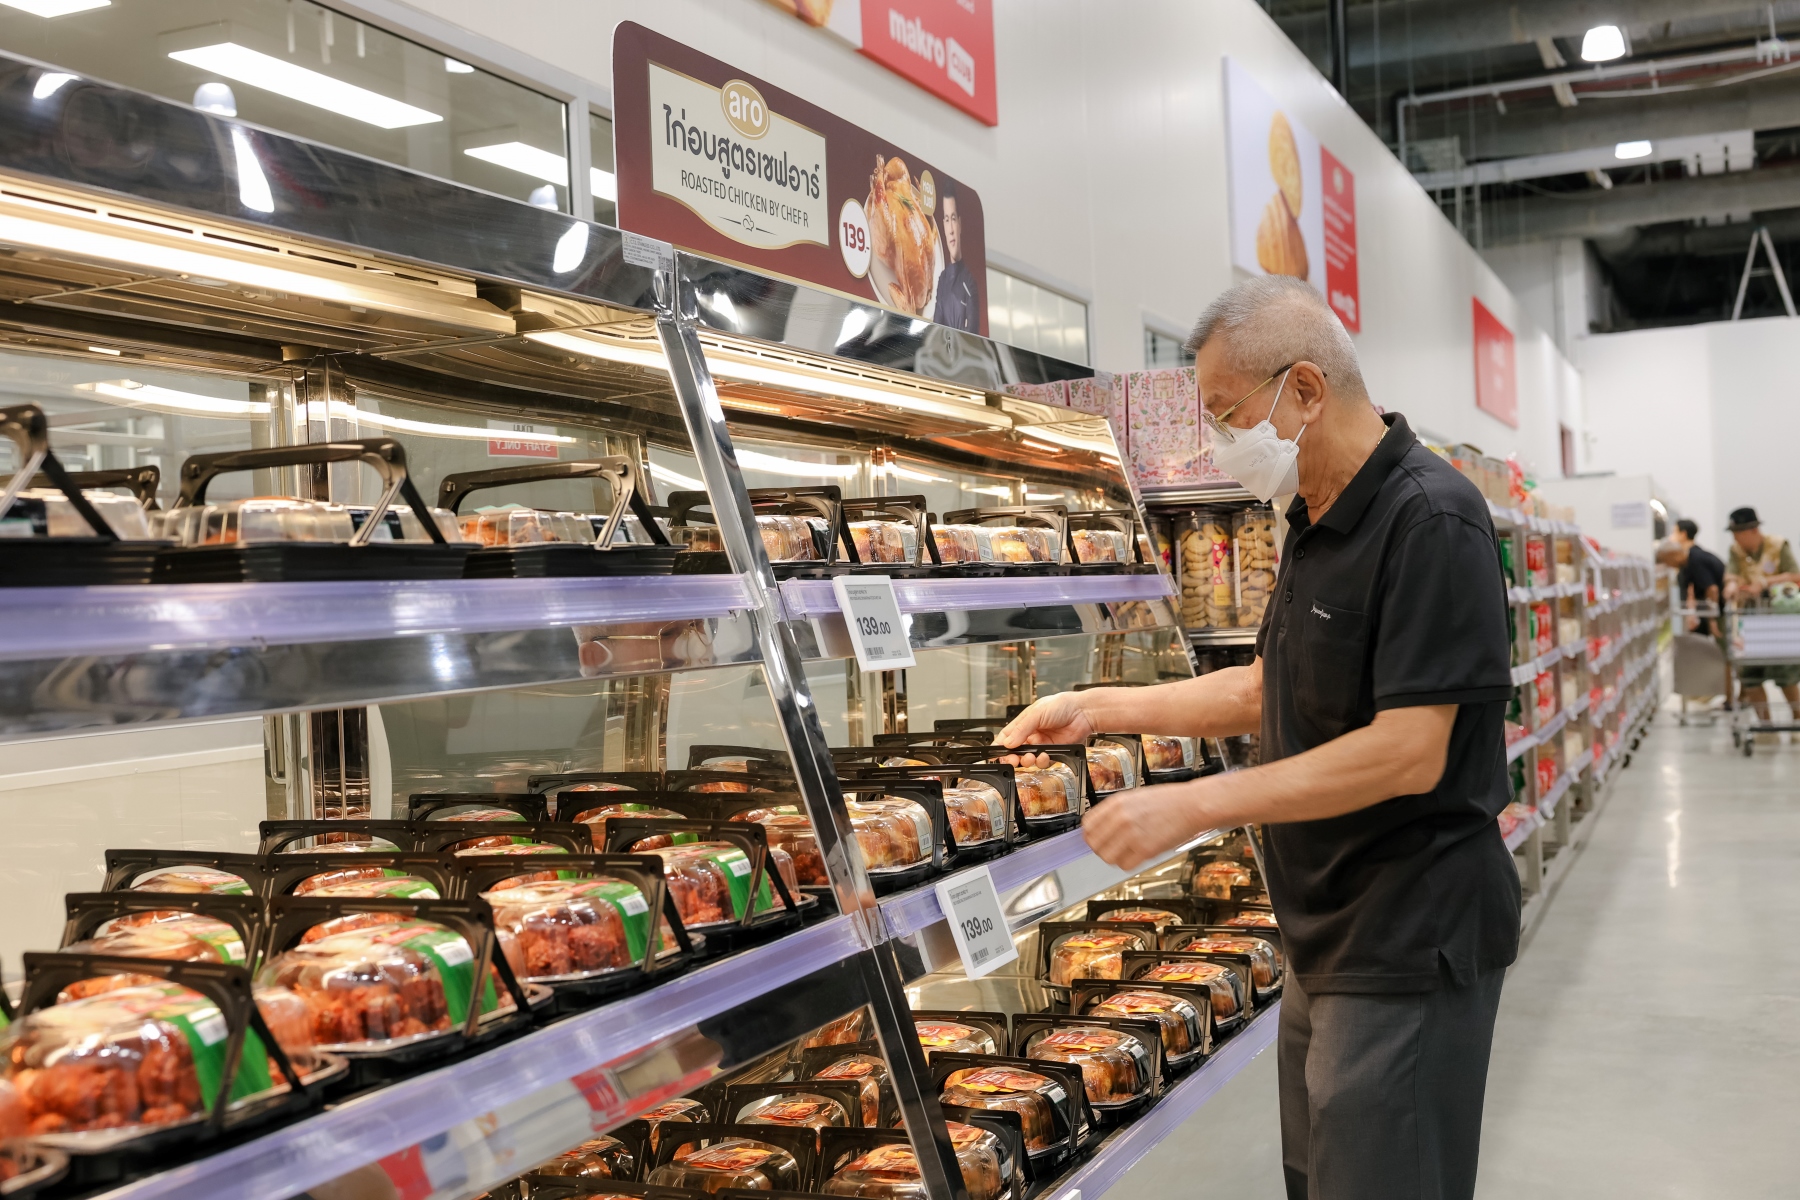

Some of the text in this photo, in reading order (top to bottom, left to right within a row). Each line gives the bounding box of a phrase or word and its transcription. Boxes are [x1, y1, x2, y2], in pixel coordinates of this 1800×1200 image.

[888, 8, 945, 69] makro
[729, 90, 763, 128] aro
[663, 103, 820, 199] ไก่อบสูตรเชฟอาร์
[681, 169, 809, 228] ROASTED CHICKEN BY CHEF R
[856, 616, 891, 636] 139.00
[961, 916, 994, 941] 139.00
